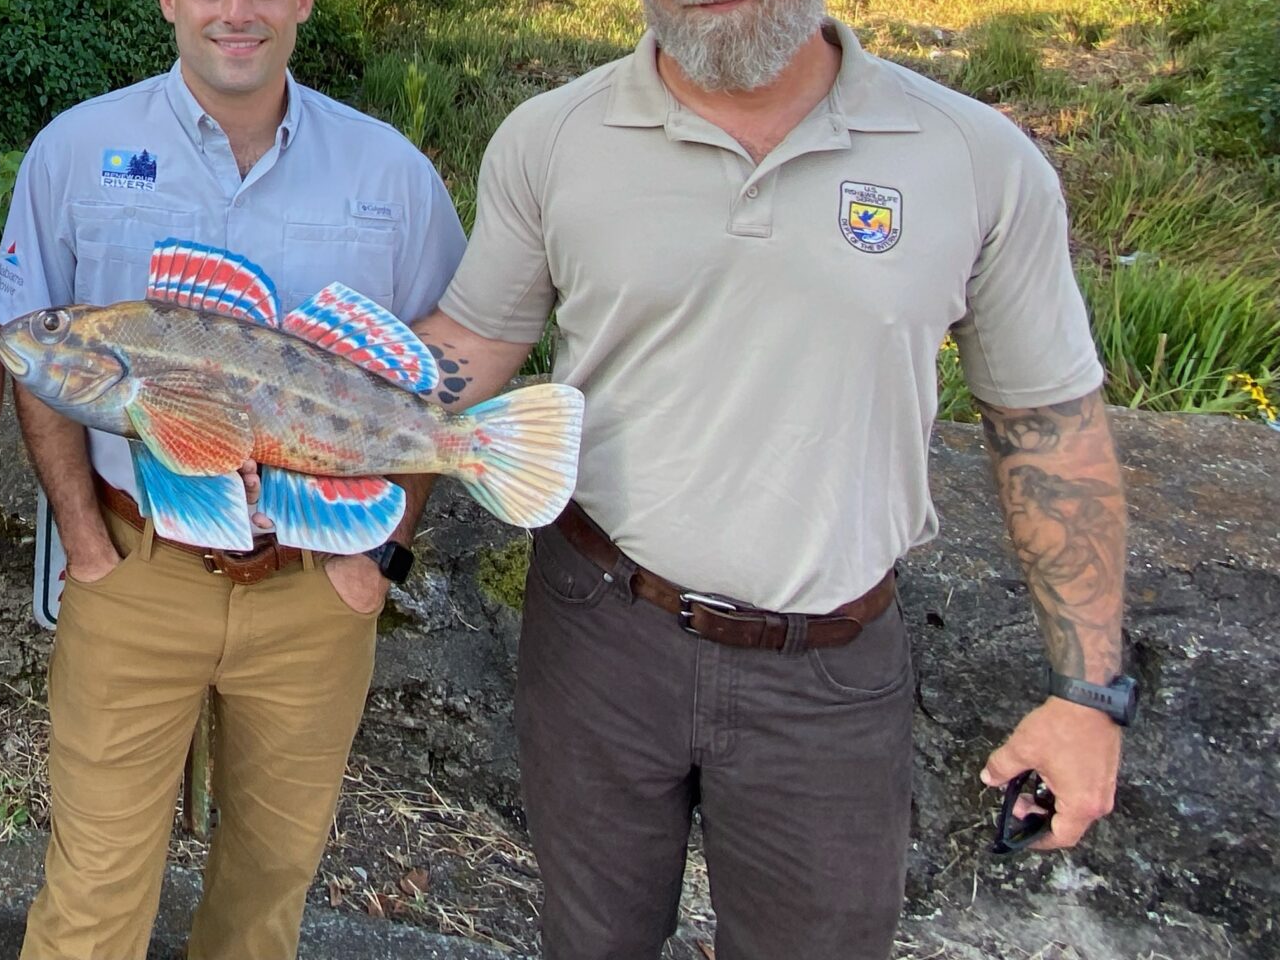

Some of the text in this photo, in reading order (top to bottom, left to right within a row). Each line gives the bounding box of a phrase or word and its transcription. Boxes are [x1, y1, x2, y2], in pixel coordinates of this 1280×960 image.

[134, 174, 154, 183] OUR
[103, 178, 154, 190] RIVERS
[861, 243, 874, 251] THE
